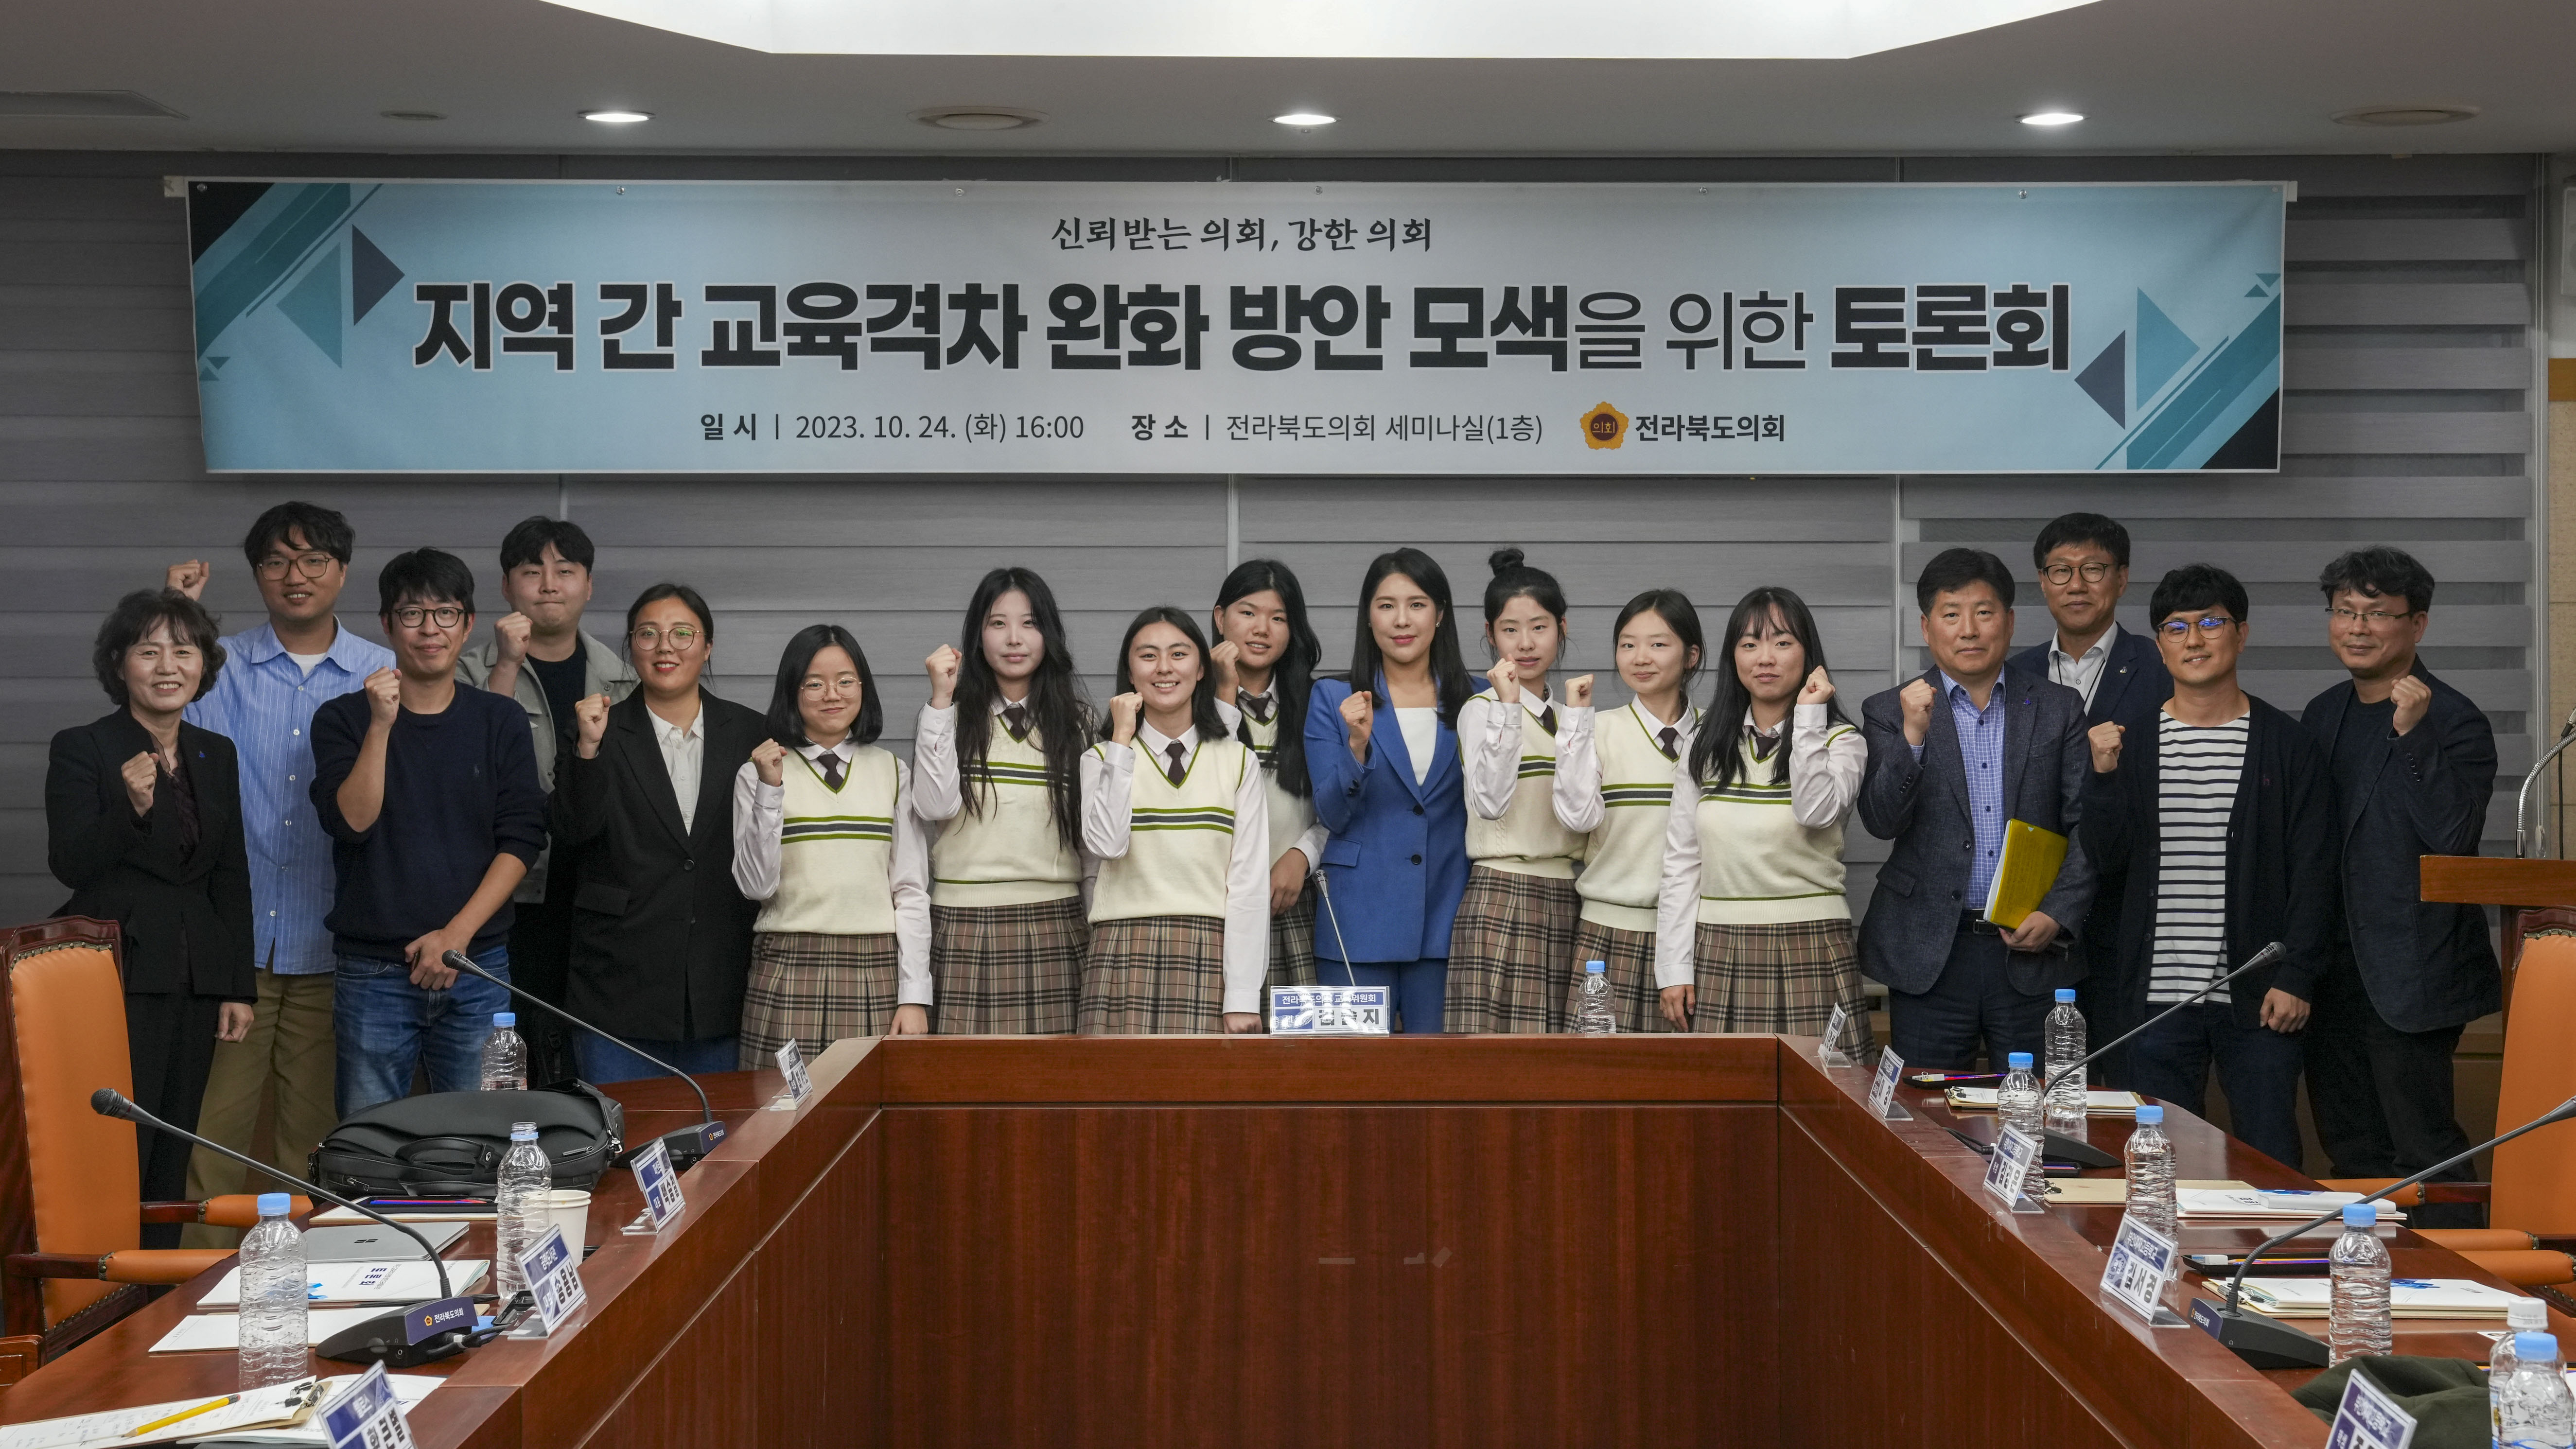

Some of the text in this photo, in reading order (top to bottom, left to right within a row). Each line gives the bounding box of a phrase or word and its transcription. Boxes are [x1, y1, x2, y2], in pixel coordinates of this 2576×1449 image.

[1051, 217, 1432, 252] 신뢰받는 의회, 강한 의회
[414, 281, 2070, 373] 지역 간 교육격차 완화 방안 모색을 위한 토론회
[796, 415, 865, 439] 2023.
[874, 415, 911, 439] 10.
[918, 415, 956, 439] 24.
[964, 413, 1007, 443] (화)
[1016, 415, 1085, 439] 16:00
[1226, 414, 1375, 441] 전라북도의회
[1385, 414, 1543, 445] 세미나실(1층)
[1592, 421, 1615, 433] 의회
[1635, 414, 1785, 442] 전라북도의회
[434, 1307, 464, 1324] 전라북도의회
